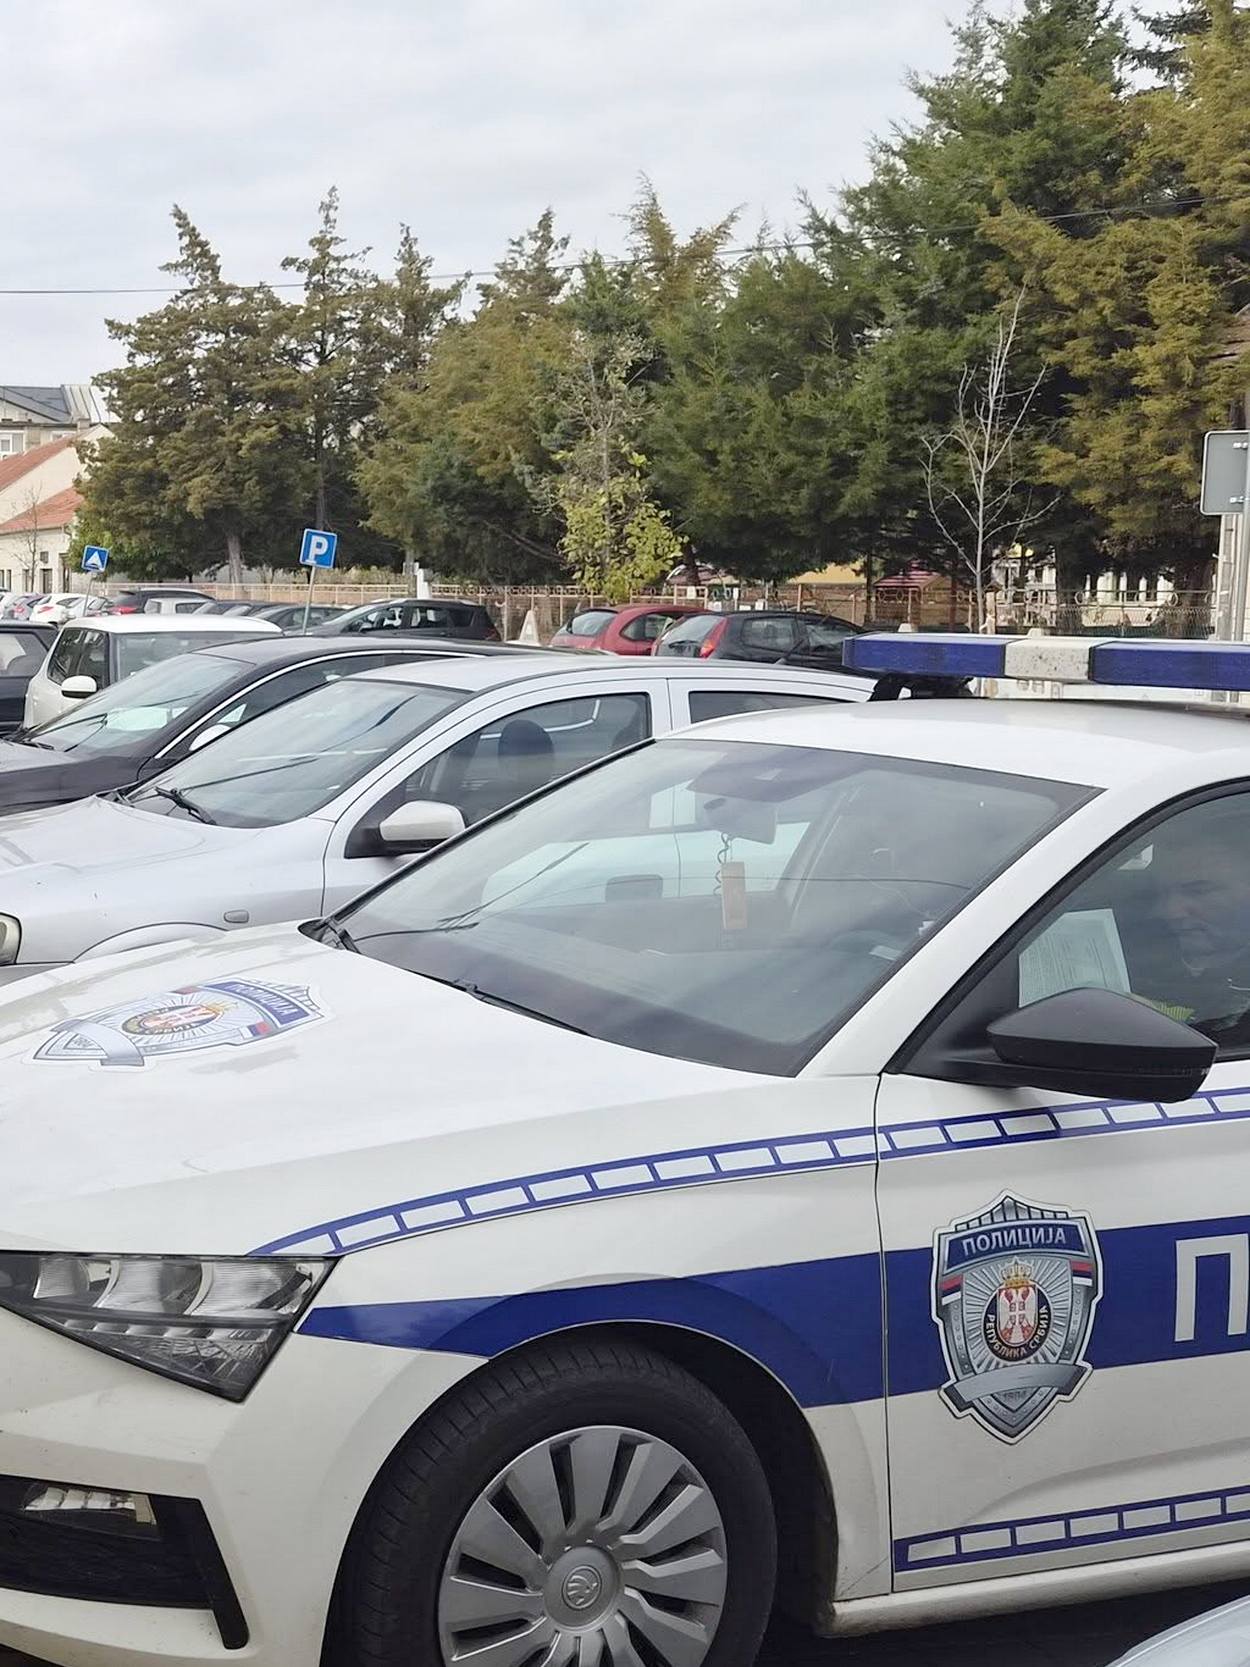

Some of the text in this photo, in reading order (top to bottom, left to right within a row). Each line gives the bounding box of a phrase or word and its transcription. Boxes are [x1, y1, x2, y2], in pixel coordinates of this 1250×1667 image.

[308, 534, 328, 561] P
[962, 1226, 1067, 1256] ПОЛИЦИЈА
[986, 1305, 1049, 1358] РЕПУБЛИКА СРБИЈА
